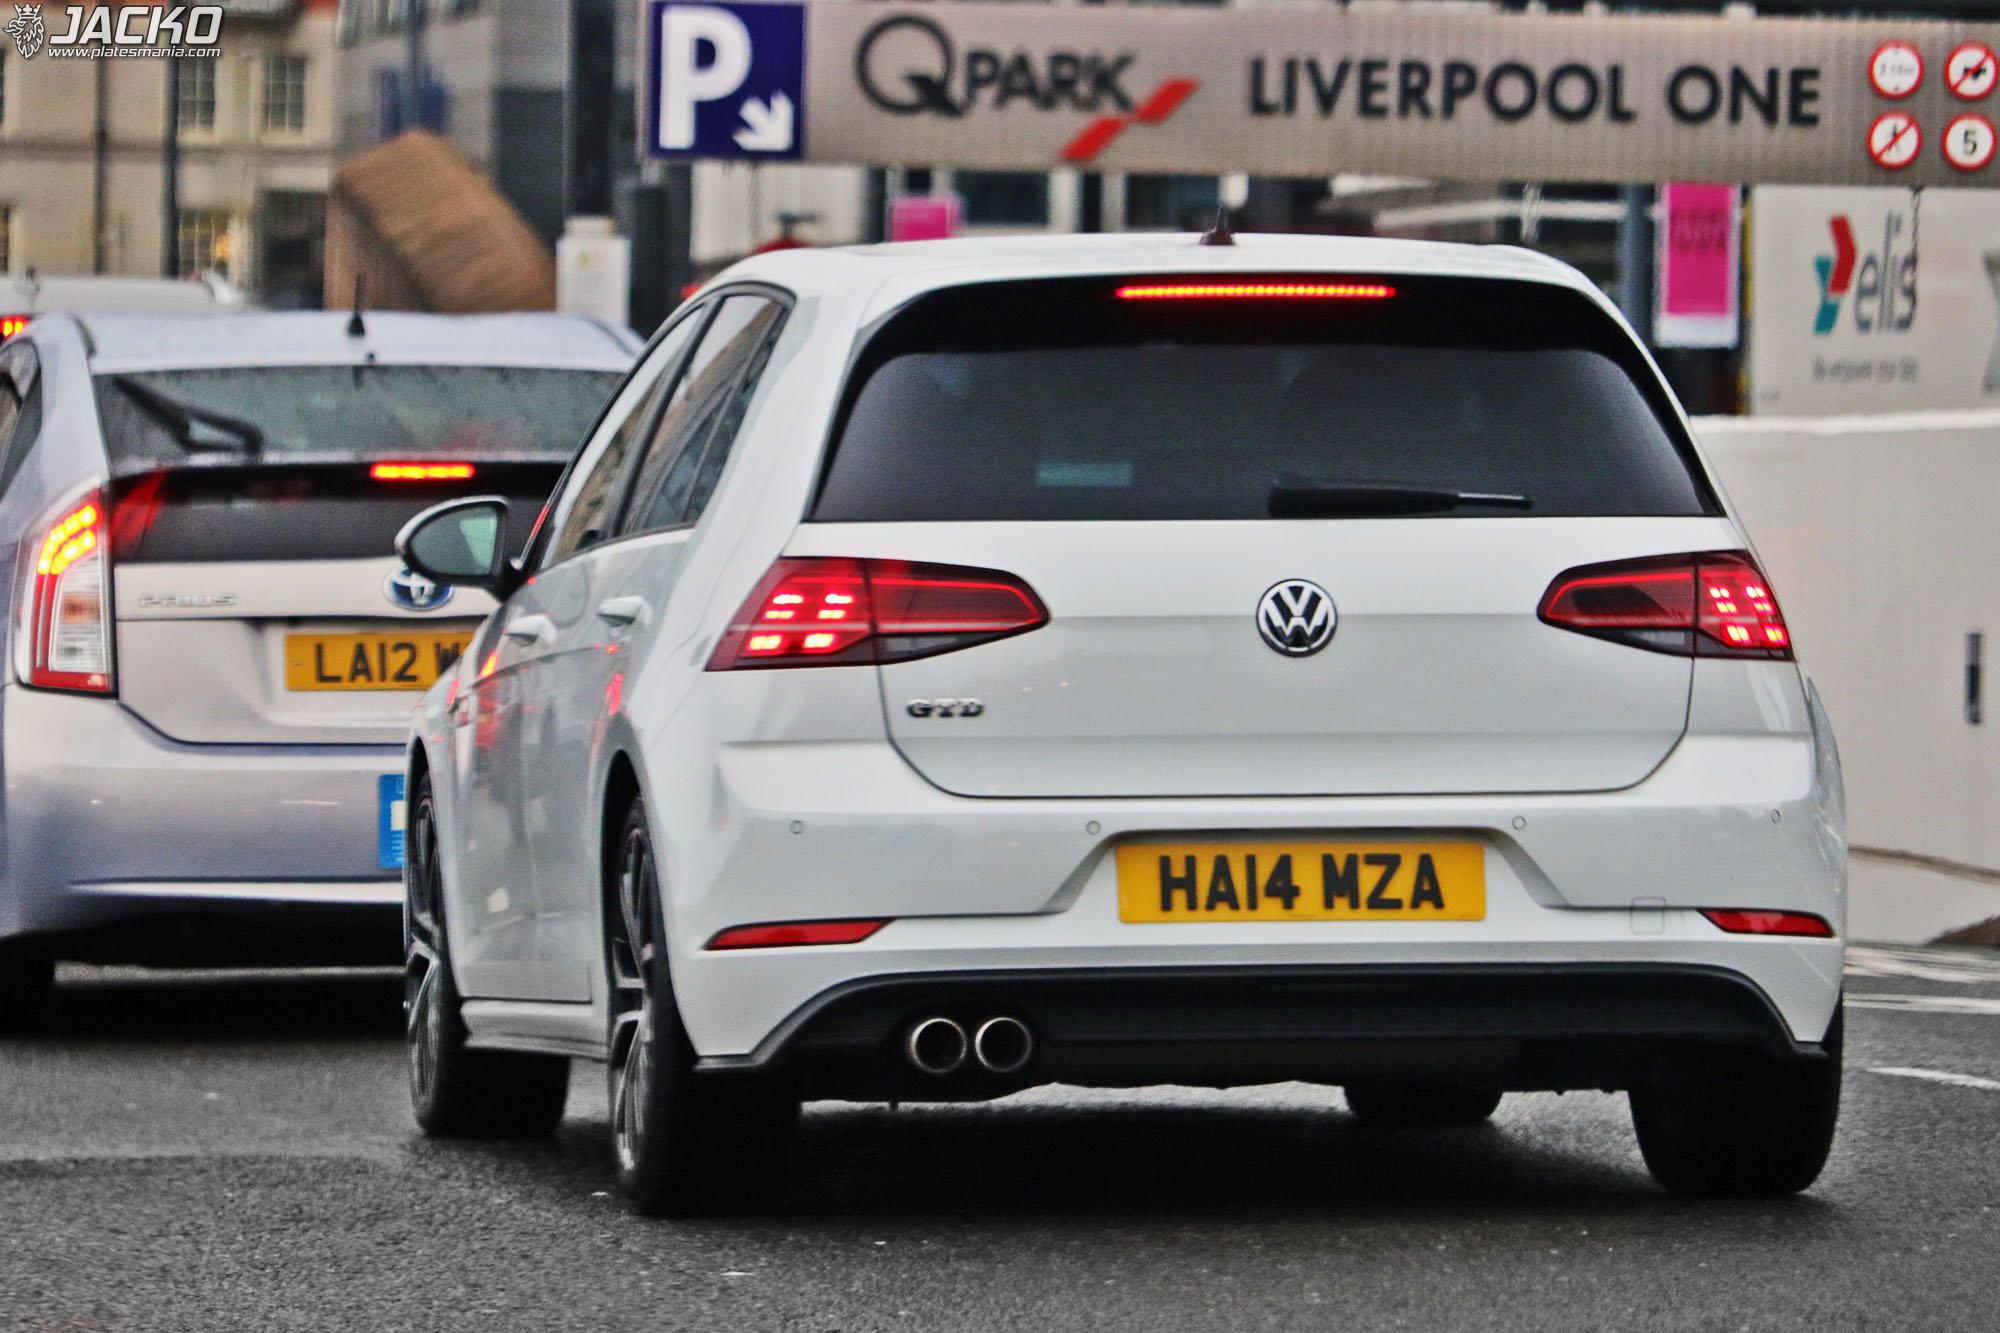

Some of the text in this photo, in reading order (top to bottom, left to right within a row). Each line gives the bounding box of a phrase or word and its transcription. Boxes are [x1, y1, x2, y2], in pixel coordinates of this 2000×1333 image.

[658, 6, 752, 150] P
[1249, 57, 1821, 127] LIVERPOOL ONE
[1963, 130, 1978, 156] 5
[313, 641, 468, 683] LA12 W
[906, 698, 985, 718] GTD
[1159, 852, 1445, 911] HA14 MZA
